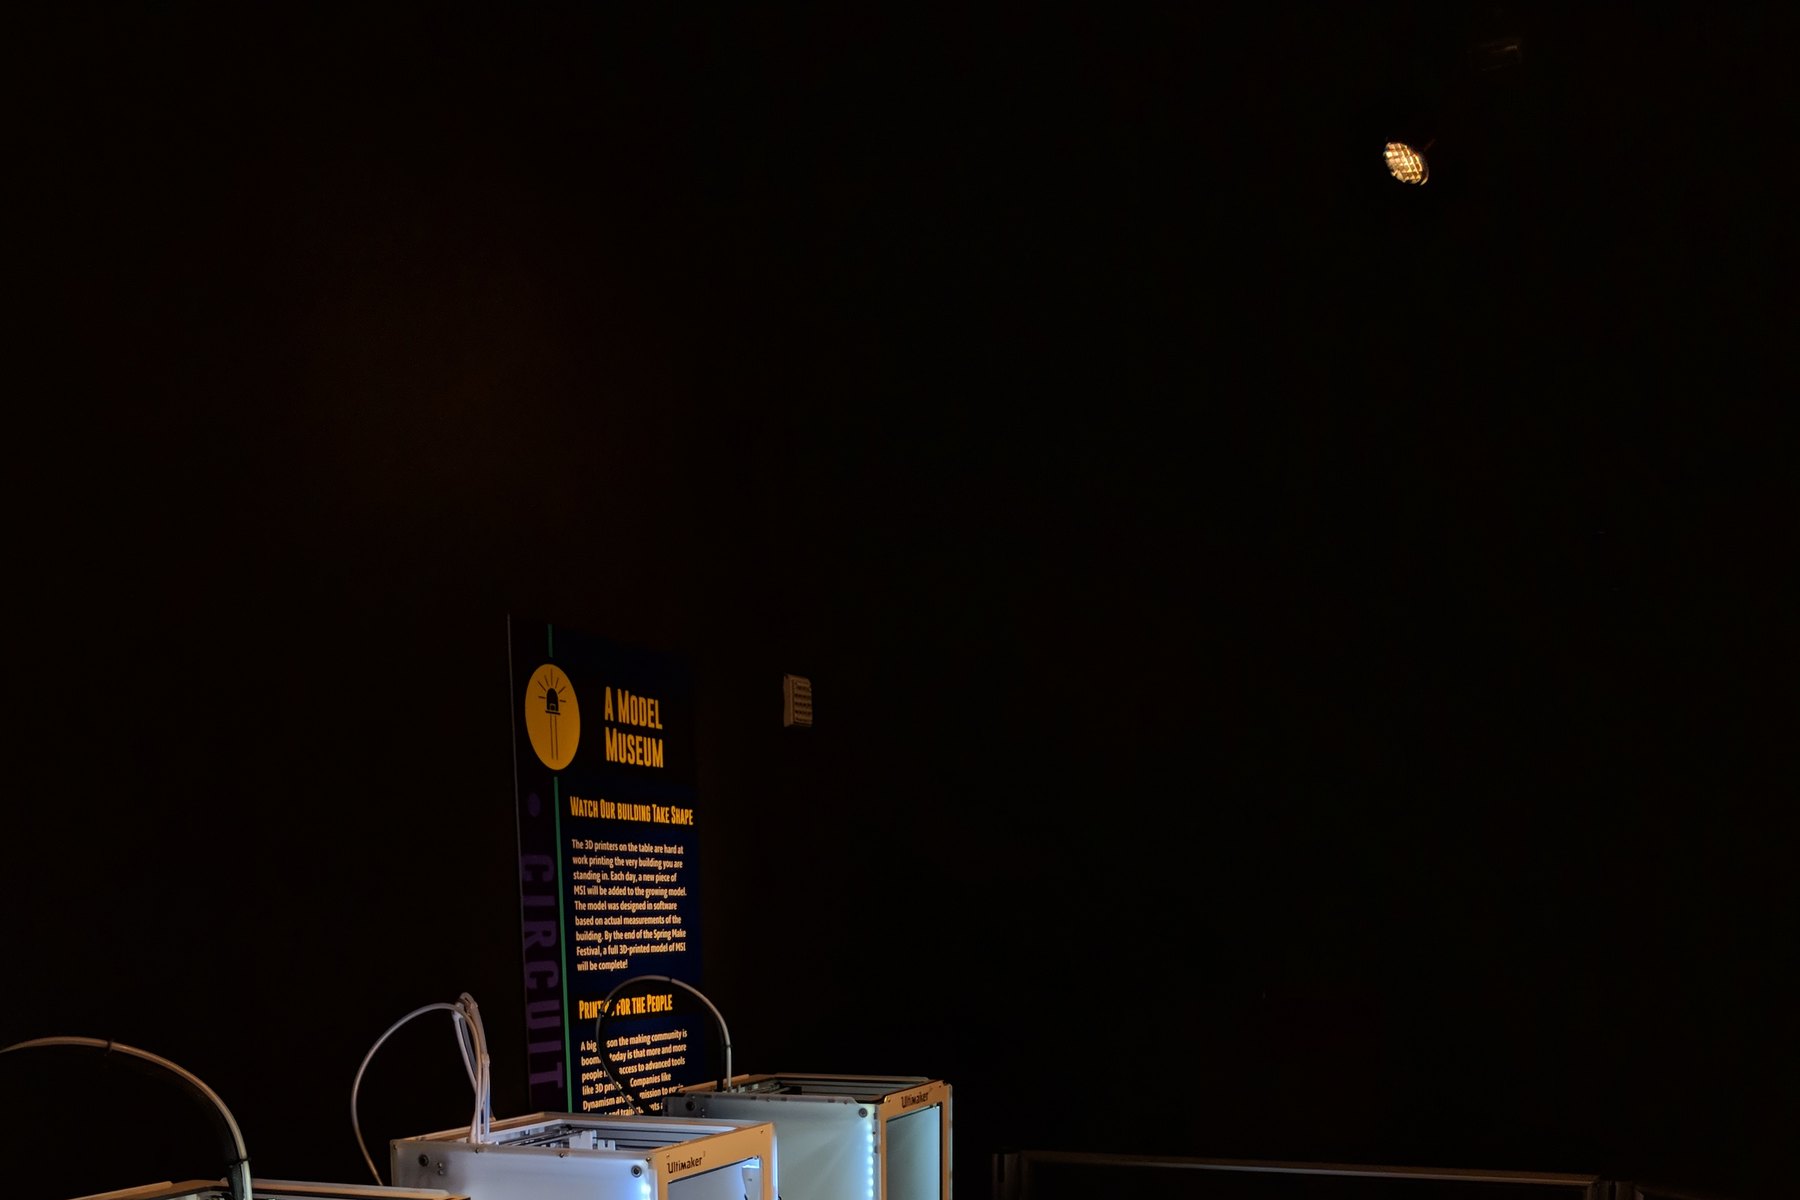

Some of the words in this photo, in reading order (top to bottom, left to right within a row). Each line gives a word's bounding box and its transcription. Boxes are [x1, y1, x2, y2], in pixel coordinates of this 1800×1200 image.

[604, 686, 614, 721] A
[617, 688, 663, 730] MODEL
[605, 726, 664, 768] MUSEUM
[570, 796, 599, 818] WATCH
[600, 799, 616, 819] OUR
[617, 802, 651, 822] BUILDING
[652, 804, 670, 823] TAKE
[671, 805, 694, 825] SHAPE
[572, 839, 584, 849] The
[585, 839, 594, 850] 3D
[594, 840, 619, 852] printers
[619, 843, 628, 851] on
[628, 842, 638, 852] the
[638, 843, 654, 853] table
[654, 845, 664, 853] are
[664, 844, 677, 854] hard
[677, 845, 684, 854] at
[572, 855, 589, 865] work
[589, 855, 614, 868] printing
[614, 856, 625, 867] the
[625, 859, 638, 869] very
[638, 857, 662, 871] building
[662, 860, 674, 870] you
[673, 860, 683, 869] are
[573, 870, 601, 883] standing
[601, 870, 610, 880] in.
[610, 871, 625, 881] Each
[625, 871, 638, 884] day,
[638, 873, 643, 881] a
[643, 874, 655, 882] new
[655, 872, 671, 884] piece
[670, 872, 678, 882] of
[587, 885, 599, 895] will
[599, 885, 608, 896] be
[608, 886, 627, 896] added
[627, 886, 635, 896] to
[634, 886, 645, 896] the
[645, 886, 668, 899] growing
[668, 886, 688, 897] model.
[574, 900, 587, 910] The
[587, 900, 607, 910] model
[607, 902, 620, 910] was
[620, 900, 647, 913] designed
[646, 900, 653, 910] in
[653, 900, 678, 911] software
[575, 915, 594, 926] based
[594, 917, 604, 925] on
[603, 915, 623, 926] actual
[623, 915, 665, 925] measurements
[664, 914, 672, 924] of
[671, 914, 682, 924] the
[575, 930, 604, 943] building.
[604, 930, 613, 943] By
[612, 930, 624, 940] the
[623, 929, 636, 940] end
[635, 929, 643, 939] of
[642, 929, 653, 939] the
[653, 928, 672, 941] Spring
[671, 928, 687, 938] Make
[576, 945, 603, 957] Festival,
[602, 947, 608, 956] a
[607, 944, 619, 955] full
[619, 943, 651, 956] 3D-printed
[650, 943, 669, 953] model
[668, 942, 676, 952] of
[576, 960, 589, 972] will
[589, 960, 598, 971] be
[598, 958, 629, 972] complete!
[631, 996, 646, 1015] THE
[646, 993, 673, 1013] PEOPLE
[580, 1041, 586, 1053] A
[586, 1039, 598, 1053] big
[618, 1036, 629, 1046] the
[629, 1033, 652, 1046] making
[651, 1029, 682, 1042] community
[682, 1028, 688, 1038] is
[627, 1049, 633, 1060] is
[633, 1048, 646, 1059] that
[646, 1047, 662, 1057] more
[661, 1044, 673, 1055] and
[672, 1043, 688, 1054] more
[581, 1068, 604, 1083] people
[618, 1065, 638, 1075] access
[637, 1062, 645, 1073] to
[645, 1058, 672, 1071] advanced
[671, 1056, 686, 1067] tools
[582, 1085, 595, 1096] like
[594, 1082, 604, 1094] 3D
[629, 1074, 661, 1088] Companies
[660, 1071, 672, 1083] like
[582, 1096, 615, 1112] Dynamism
[638, 1088, 662, 1100] mission
[661, 1086, 669, 1097] to
[901, 1092, 929, 1108] Ultimaker
[666, 1157, 703, 1174] Ultimaker
